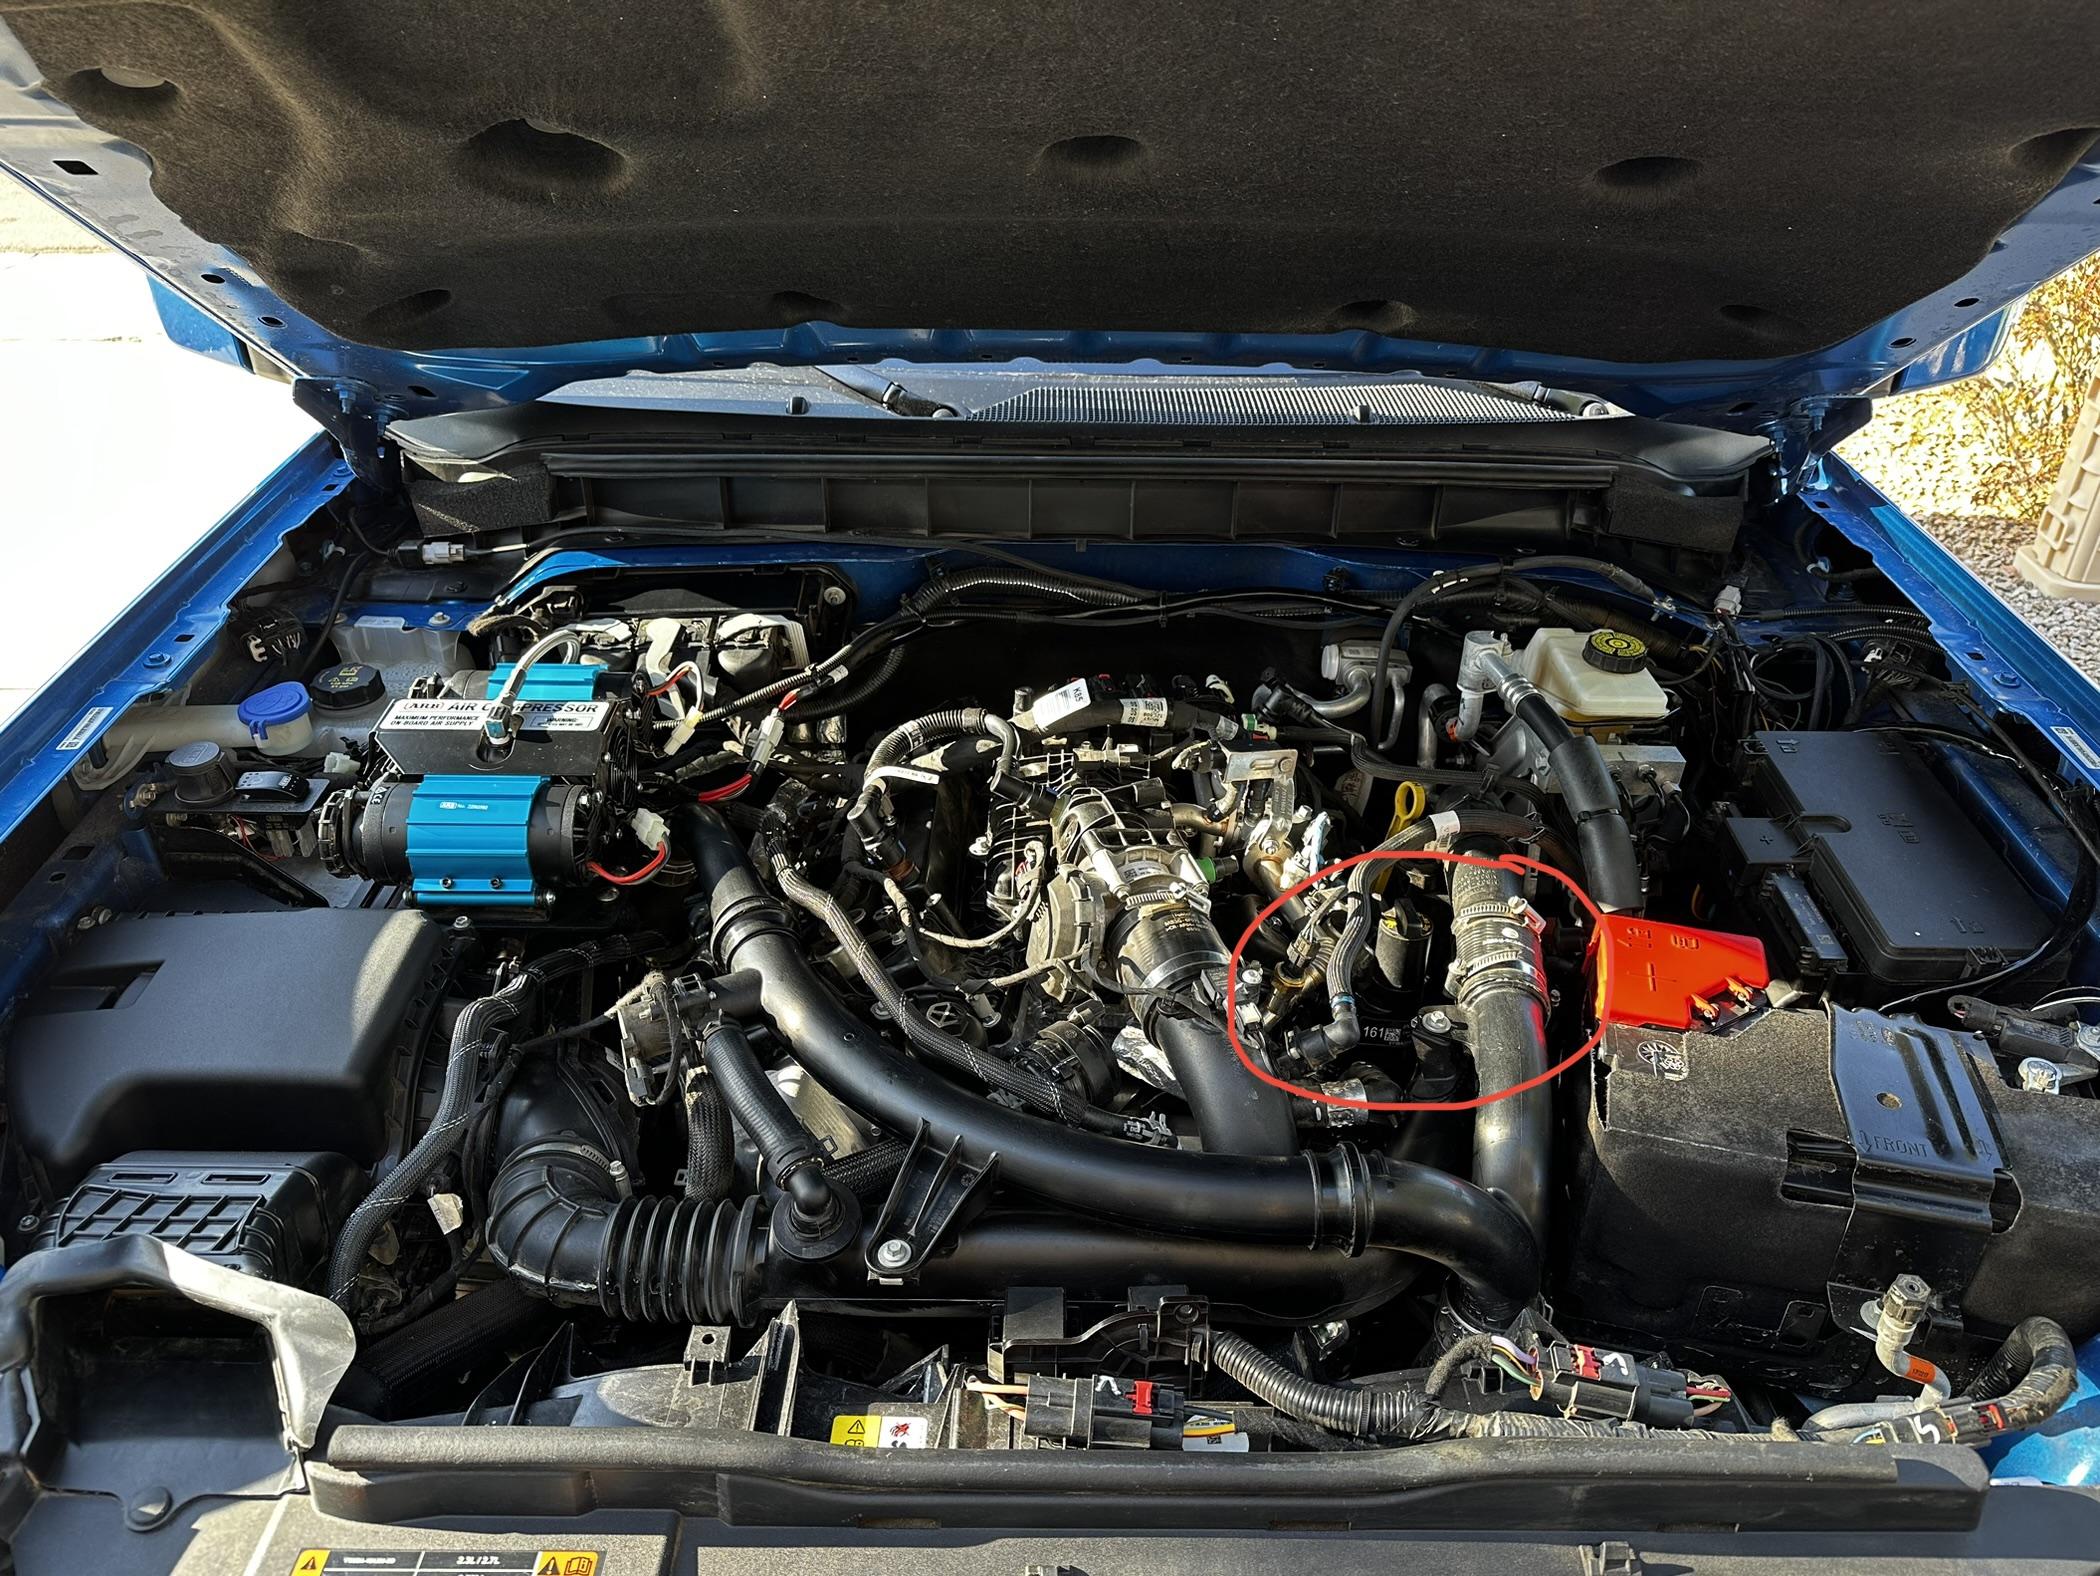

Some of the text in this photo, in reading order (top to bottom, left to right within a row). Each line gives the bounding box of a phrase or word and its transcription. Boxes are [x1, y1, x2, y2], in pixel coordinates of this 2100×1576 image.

[447, 702, 478, 711] AIR
[481, 702, 599, 713] CPRESSOR
[1363, 1026, 1384, 1038] 161
[1873, 1135, 1928, 1158] FRONT
